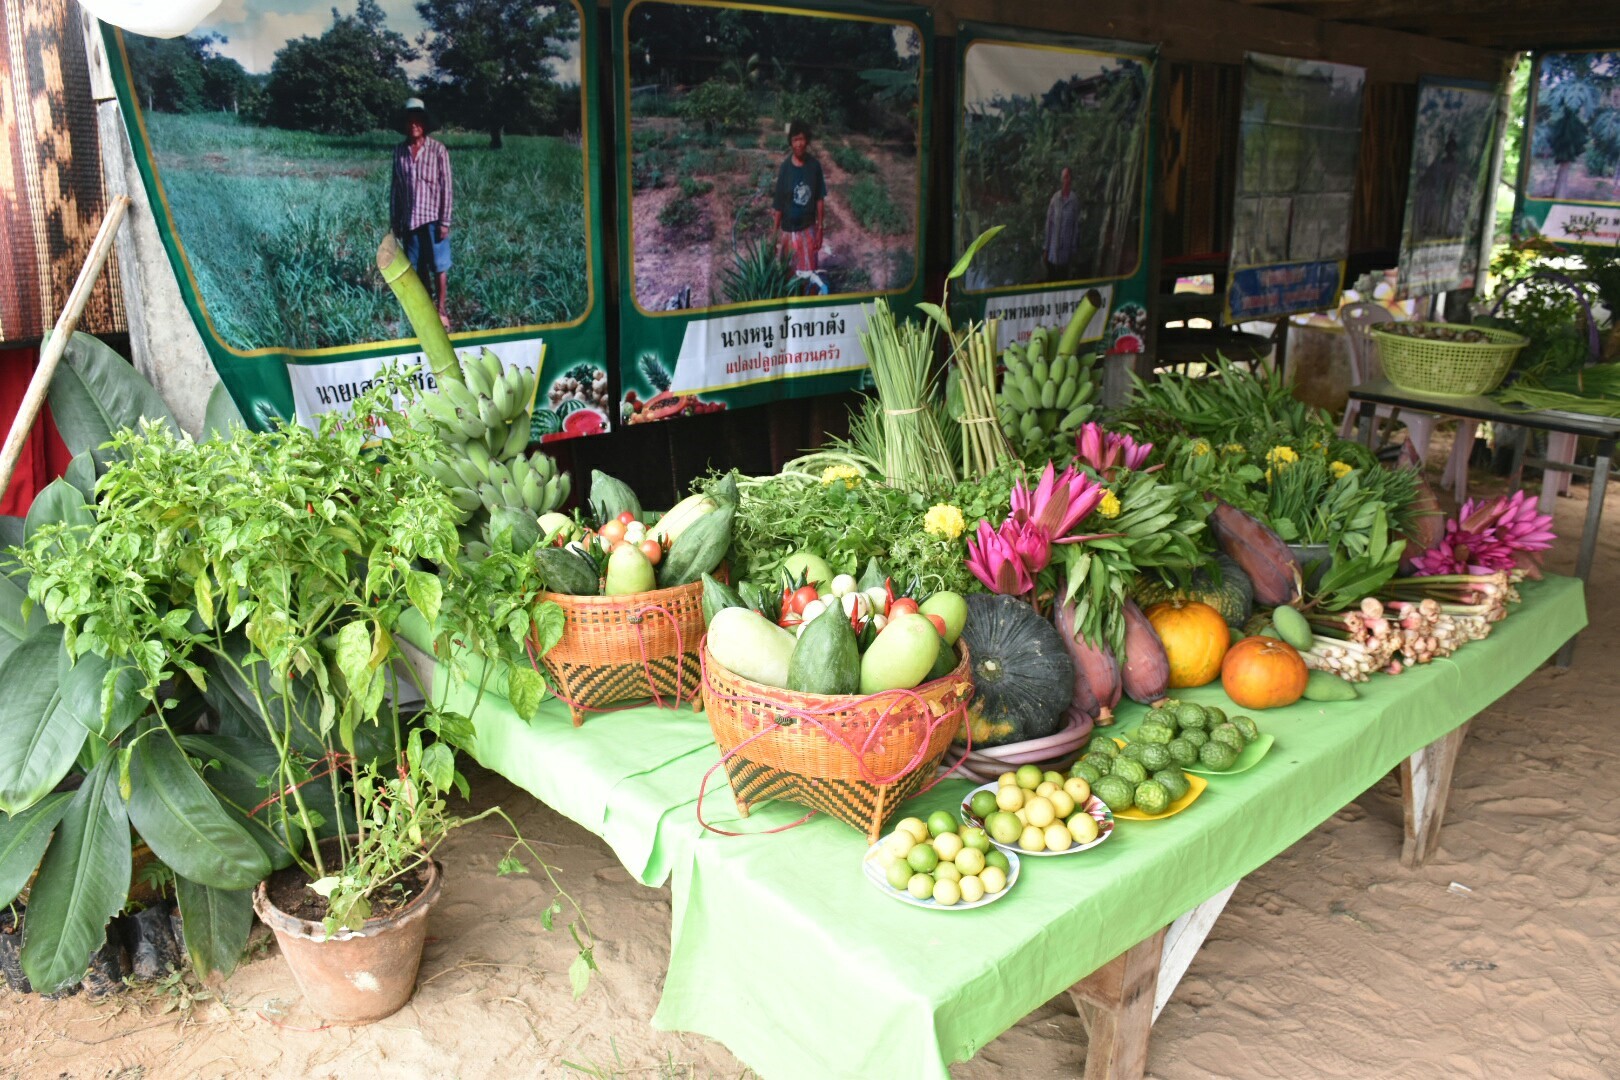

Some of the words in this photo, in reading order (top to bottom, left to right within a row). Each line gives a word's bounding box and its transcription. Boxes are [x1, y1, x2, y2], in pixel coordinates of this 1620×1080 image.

[721, 325, 774, 348] นางหนู
[726, 344, 840, 374] แปลงปลูกผักสวนครัว
